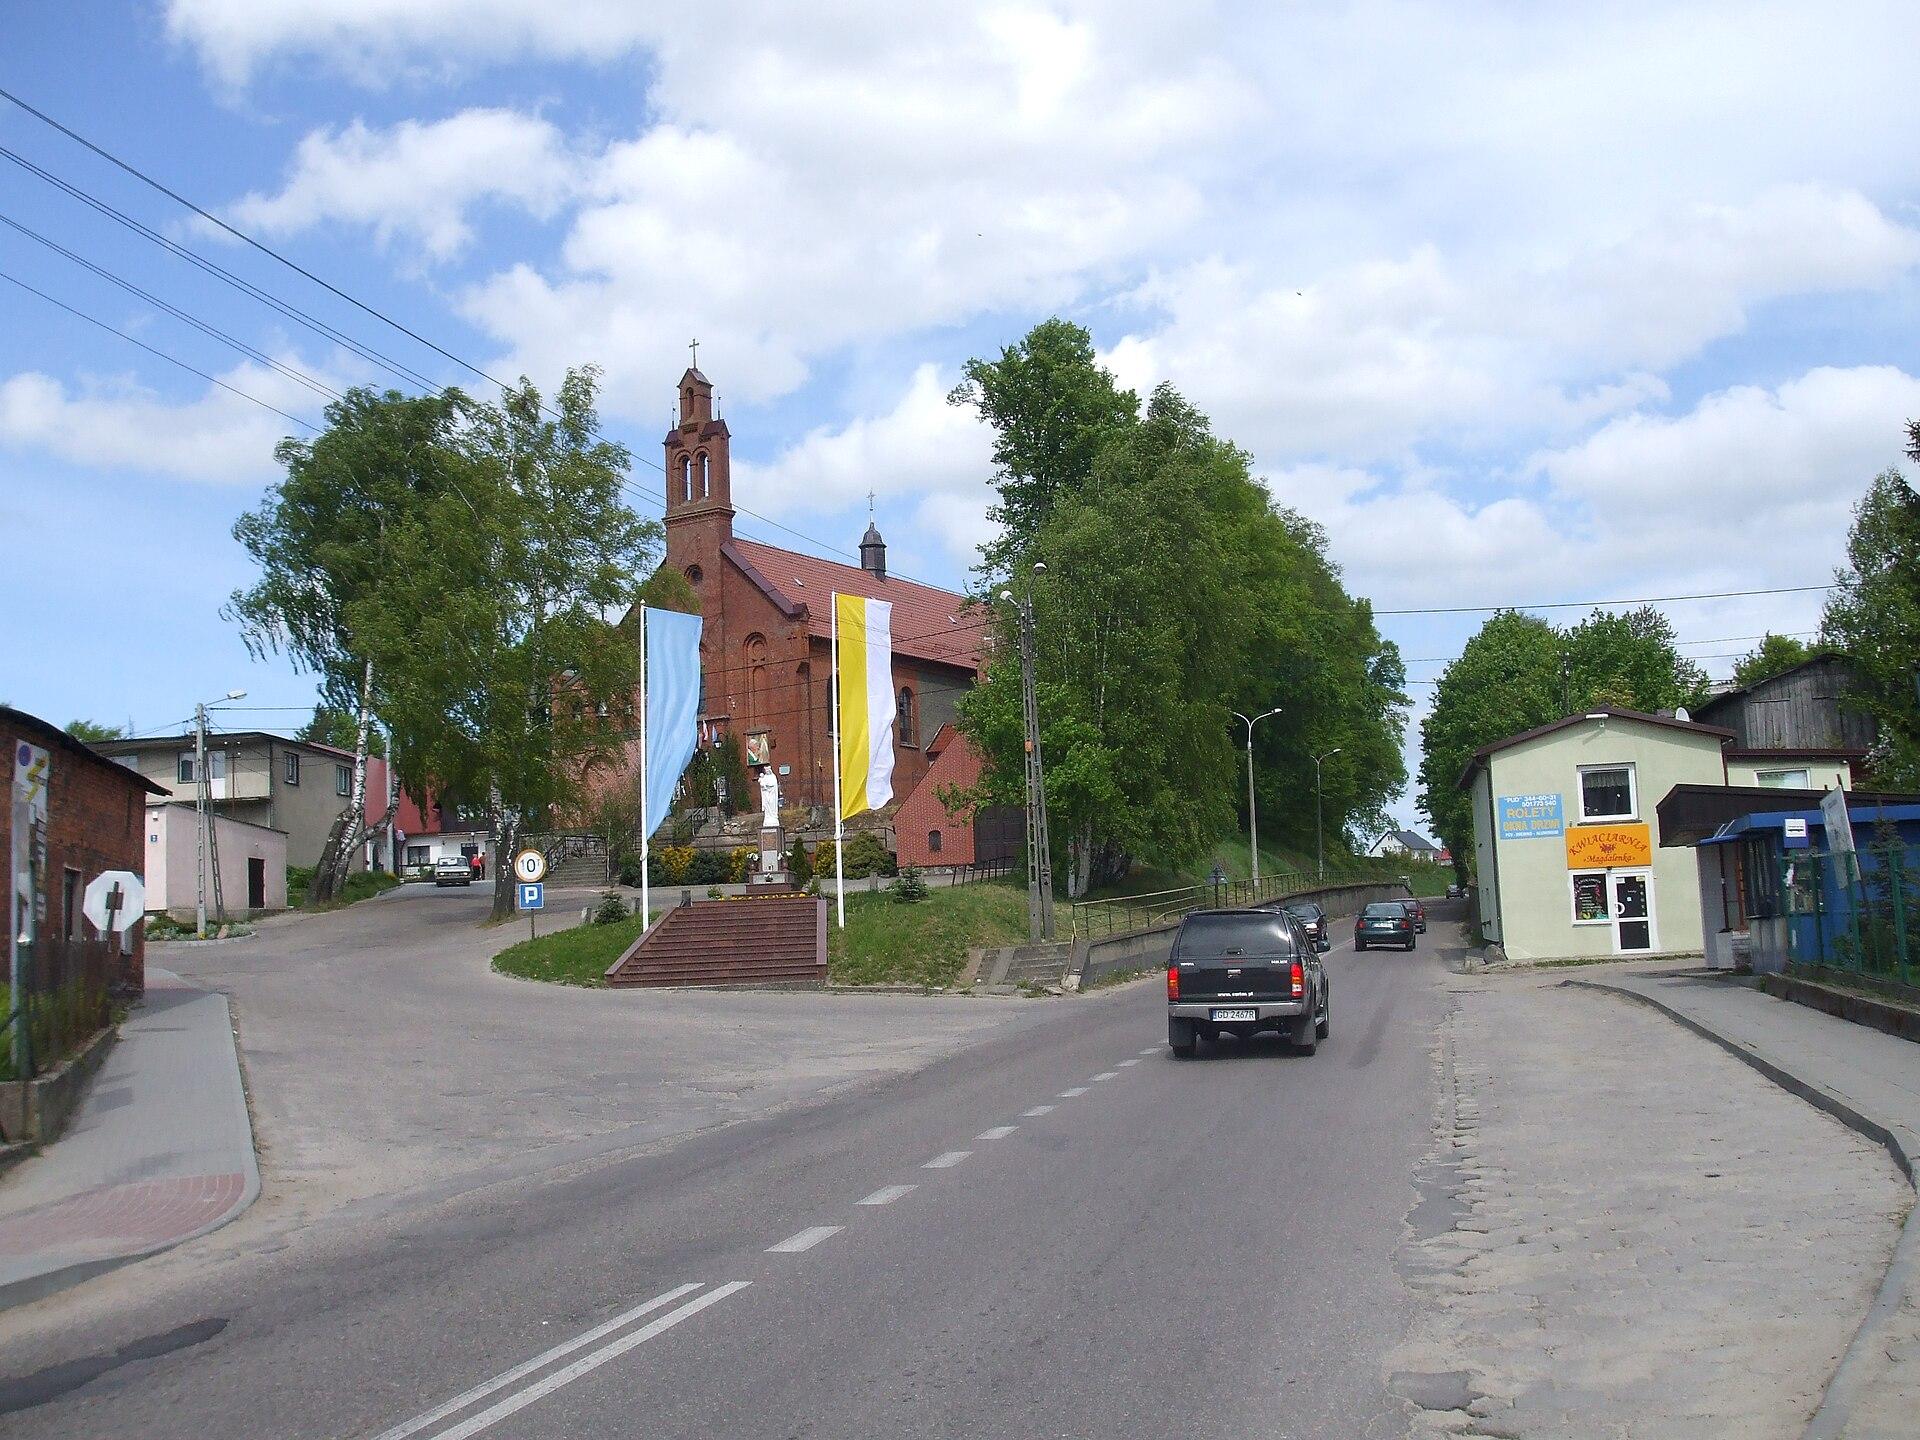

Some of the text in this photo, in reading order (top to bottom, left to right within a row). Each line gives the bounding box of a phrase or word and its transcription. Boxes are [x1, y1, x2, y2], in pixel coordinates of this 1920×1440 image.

[1507, 807, 1554, 818] ROLETY
[1569, 833, 1648, 856] KWIACIARNIA
[525, 886, 538, 904] P
[1217, 1010, 1229, 1019] GD
